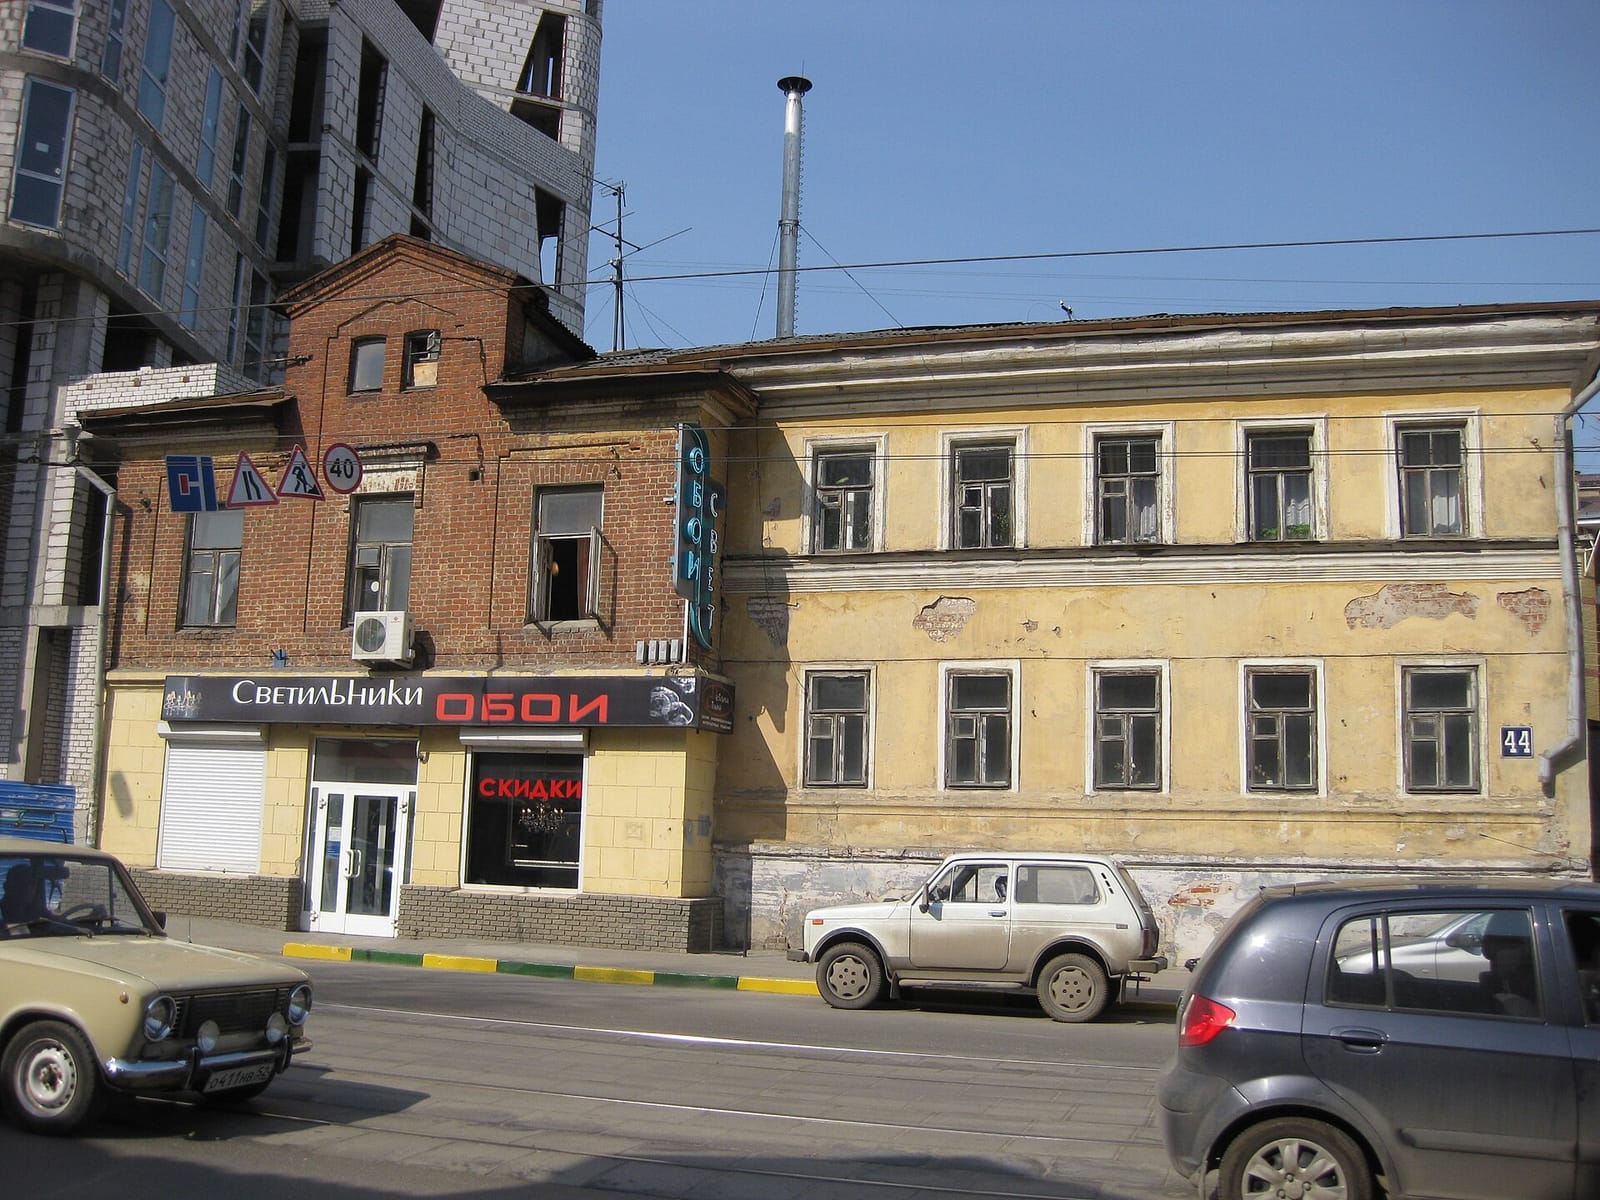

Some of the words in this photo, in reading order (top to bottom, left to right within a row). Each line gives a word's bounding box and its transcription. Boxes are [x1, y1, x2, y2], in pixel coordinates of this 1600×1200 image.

[329, 458, 354, 479] 40
[686, 446, 704, 581] ОБОИ
[436, 693, 609, 723] ОБОИ
[1504, 730, 1531, 753] 44
[479, 777, 582, 800] СКИДКИ
